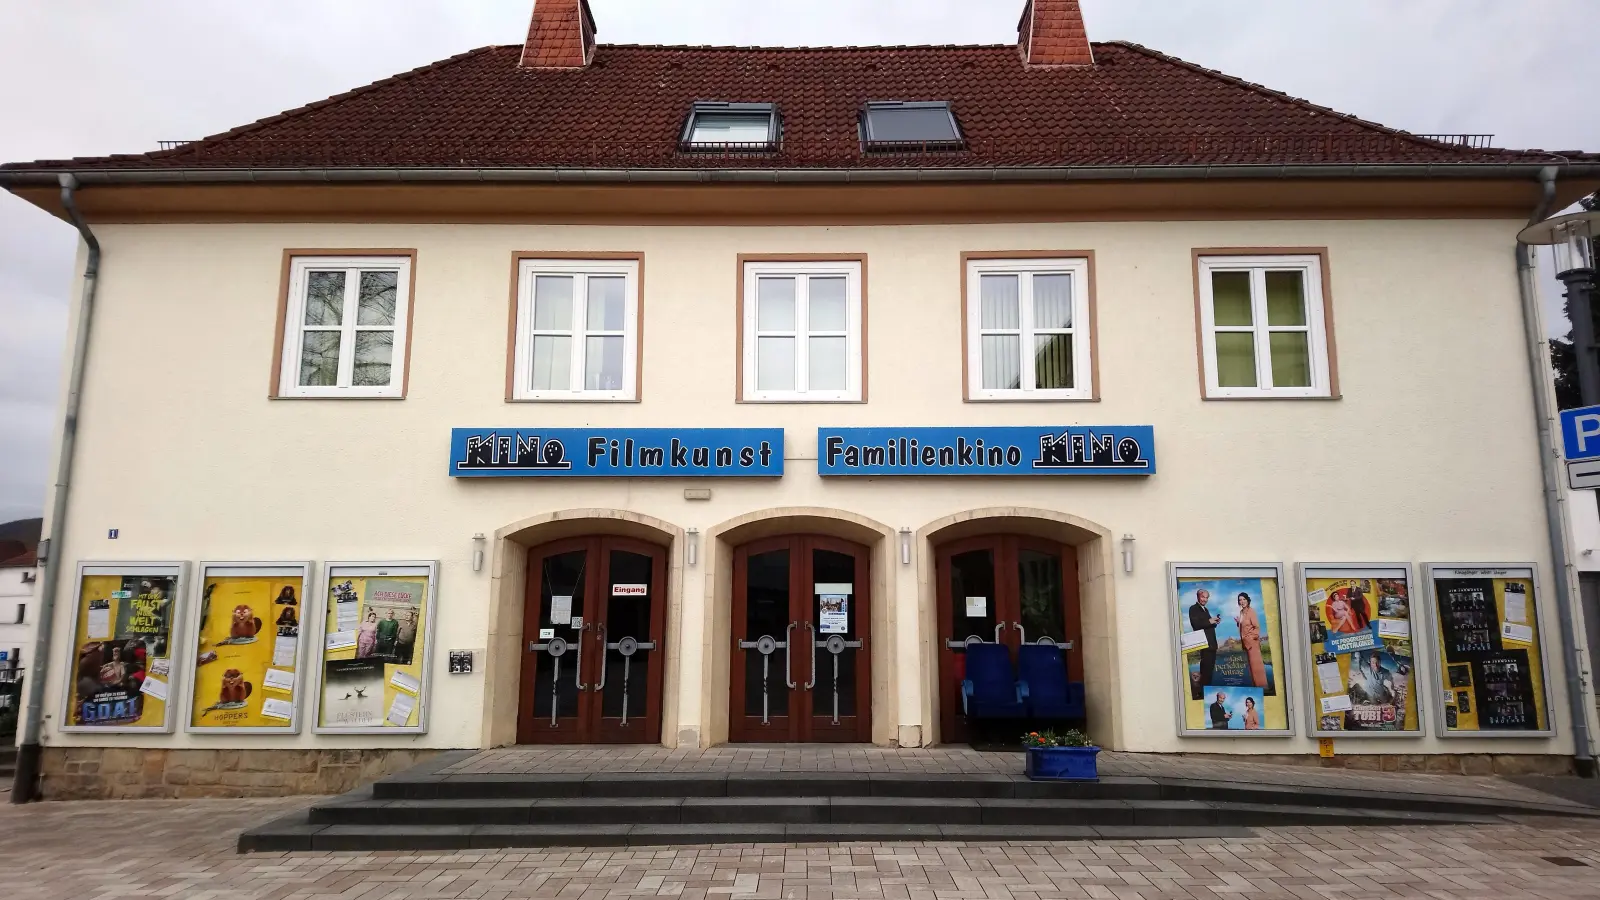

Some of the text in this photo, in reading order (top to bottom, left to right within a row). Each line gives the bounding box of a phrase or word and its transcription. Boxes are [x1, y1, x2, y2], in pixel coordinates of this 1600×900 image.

[1574, 413, 1600, 453] P
[457, 431, 773, 470] KINO Filmkunst
[825, 430, 1149, 469] Familienkino KINO
[613, 586, 646, 595] Eingang
[130, 599, 161, 610] FAUST
[130, 616, 155, 627] WELT
[82, 697, 137, 721] GOAT
[214, 712, 249, 721] HOPPERS
